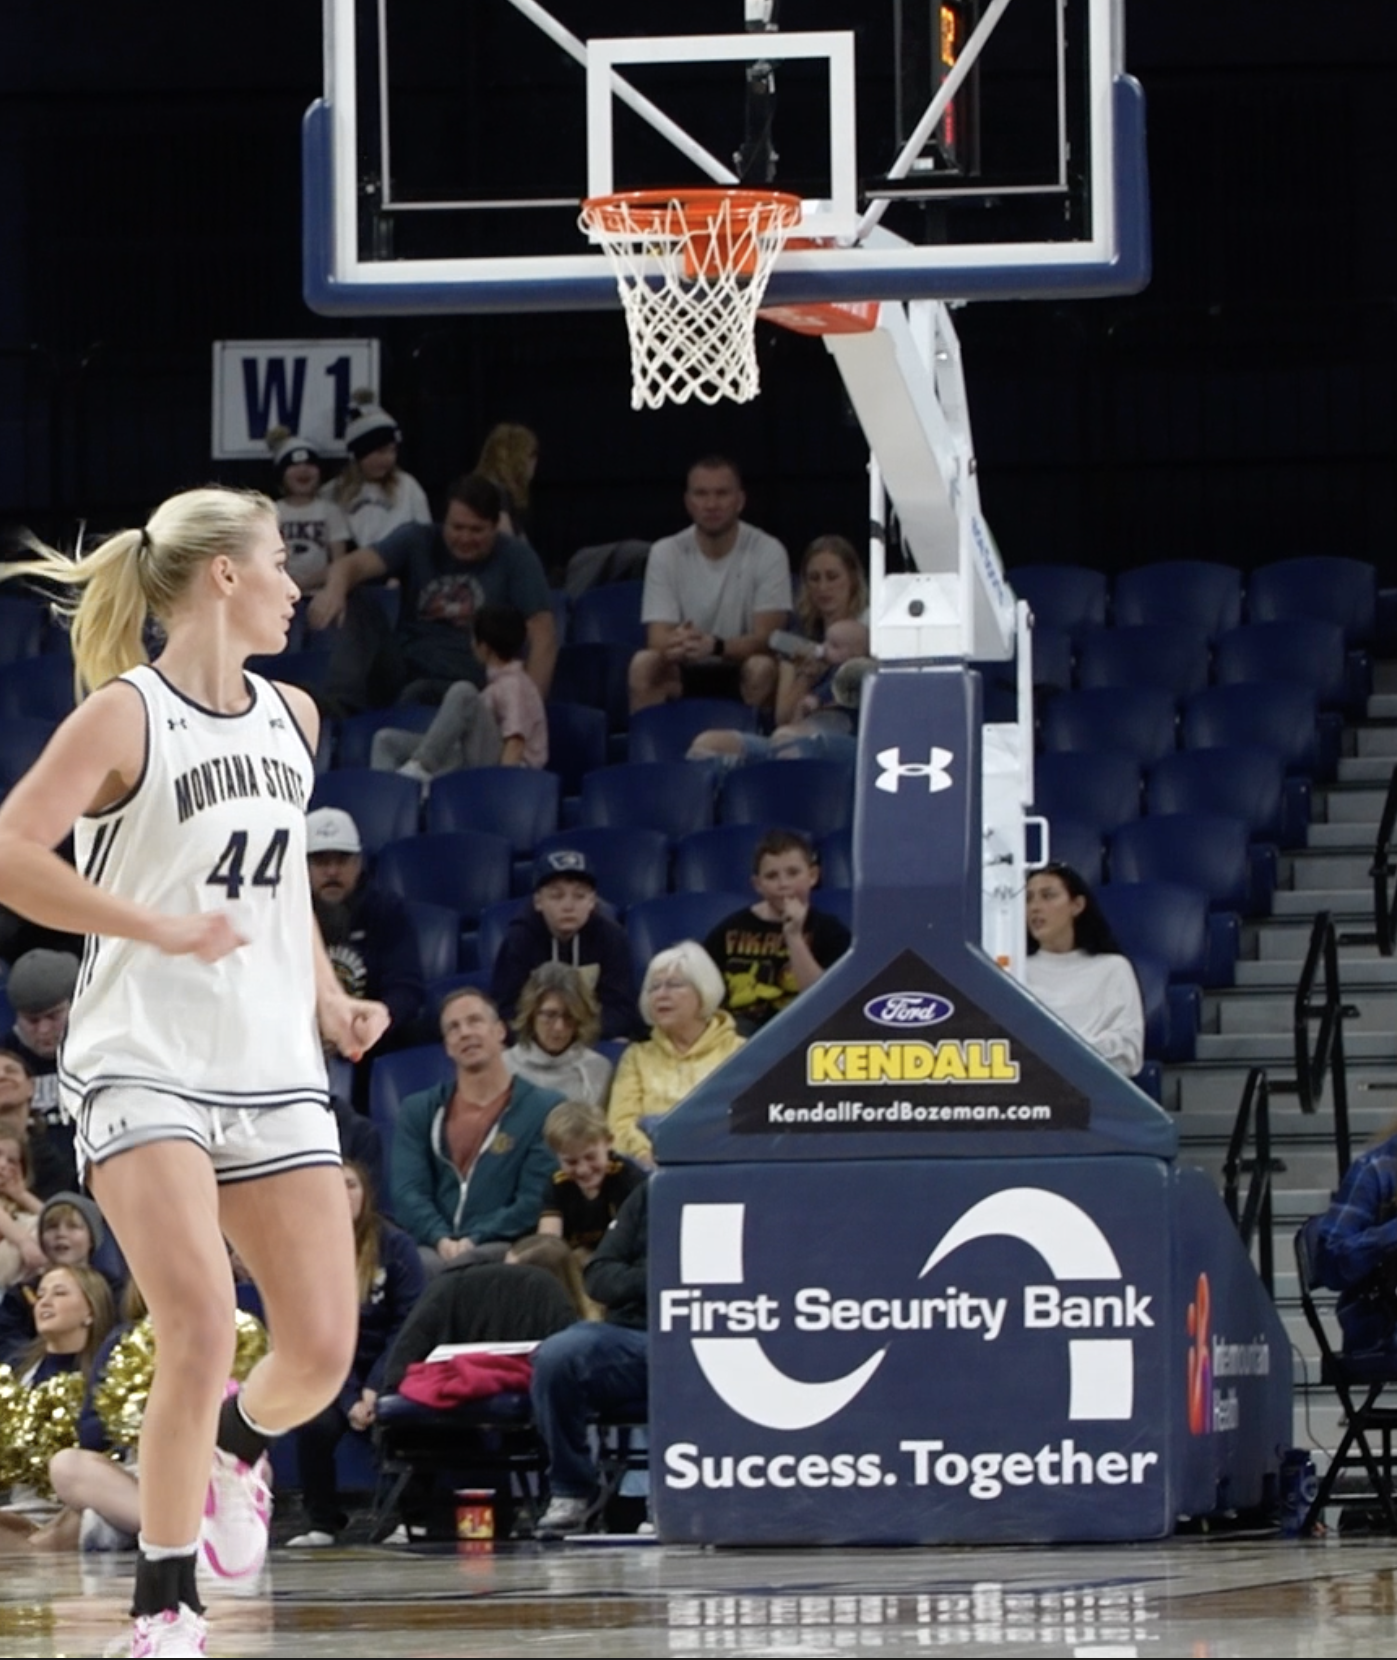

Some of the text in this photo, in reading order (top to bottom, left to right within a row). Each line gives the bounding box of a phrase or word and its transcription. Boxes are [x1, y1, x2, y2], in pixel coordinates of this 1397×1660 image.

[174, 754, 261, 824] MONTANA
[205, 829, 290, 900] 44
[879, 996, 938, 1022] Ford
[809, 1042, 1019, 1084] KENDALL
[768, 1100, 1051, 1123] KendallFordBozeman.com
[660, 1285, 1155, 1341] First Security Bank
